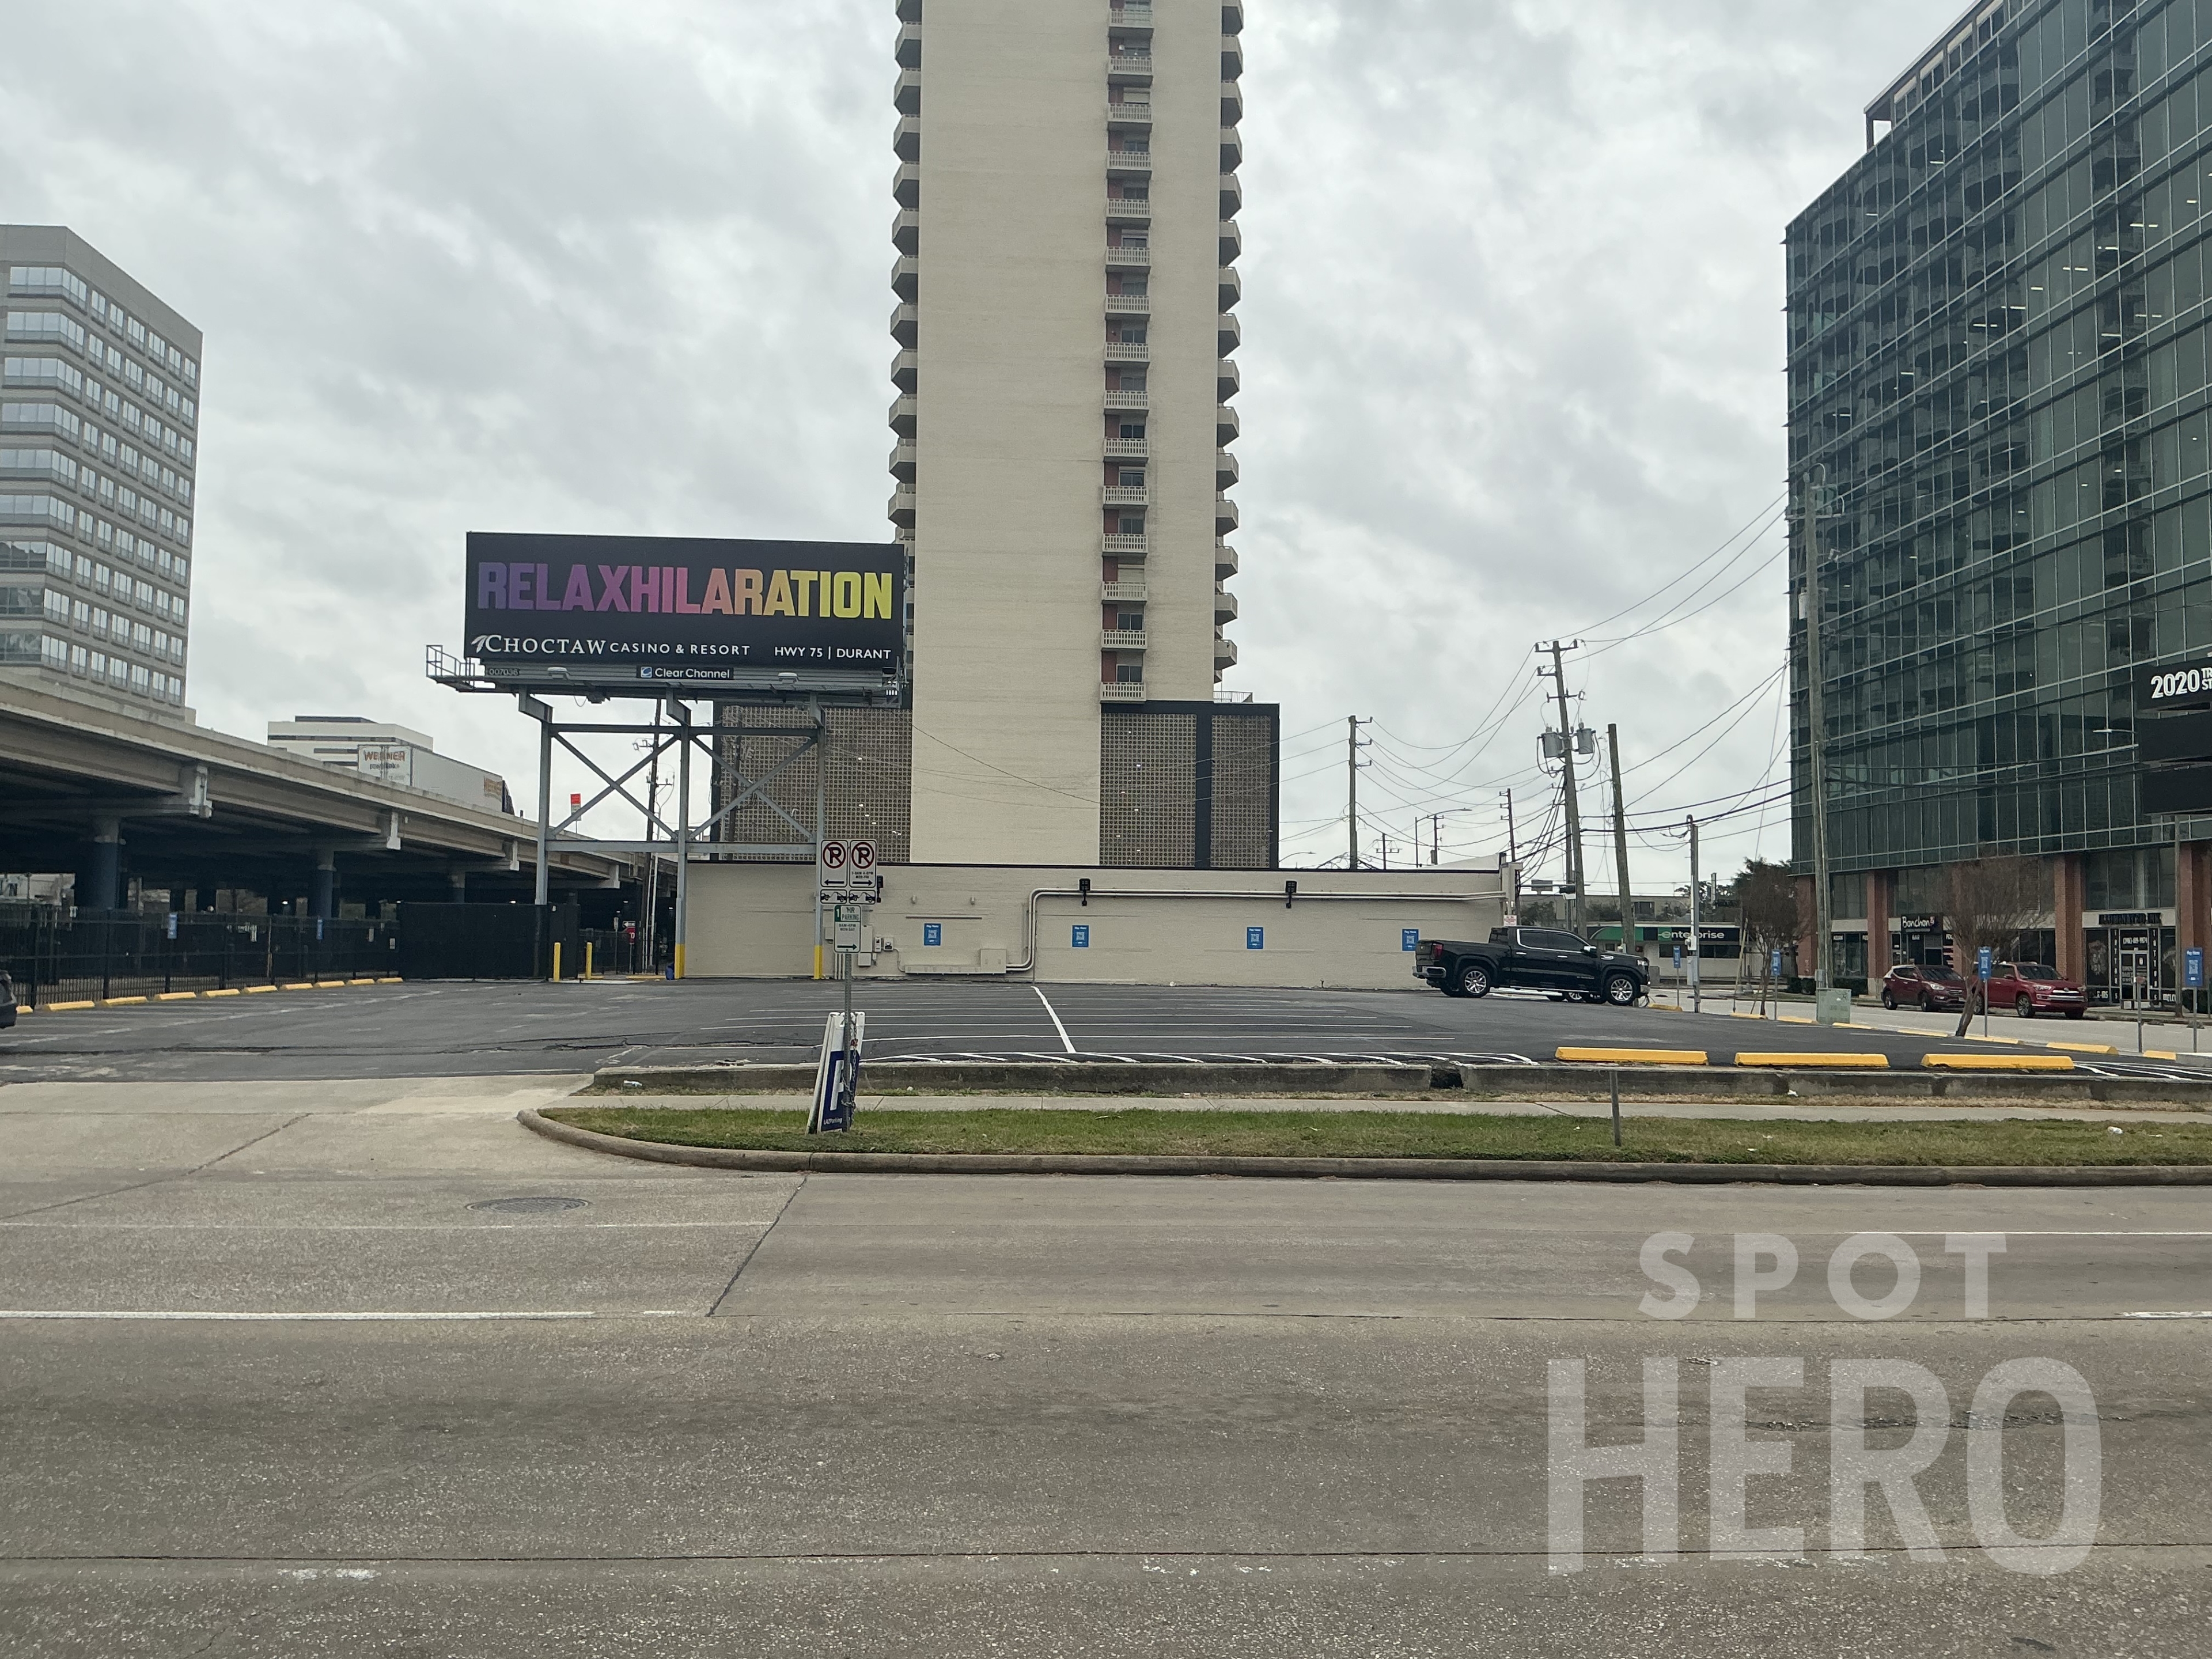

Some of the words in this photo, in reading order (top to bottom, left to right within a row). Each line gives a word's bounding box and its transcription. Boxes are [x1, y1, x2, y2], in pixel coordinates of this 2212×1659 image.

[478, 561, 892, 620] RELAXHILARATION
[485, 634, 607, 655] CHOCTAW
[609, 642, 671, 654] CASINO
[675, 644, 685, 654] &
[690, 644, 751, 656] RESORT
[774, 646, 806, 657] HWY
[809, 647, 823, 658] 75
[836, 649, 892, 660] DURANT
[655, 667, 683, 678] Clear
[685, 668, 730, 679] Channel
[2150, 669, 2200, 699] 2020
[836, 908, 840, 918] 1
[1658, 930, 1725, 939] enteprise
